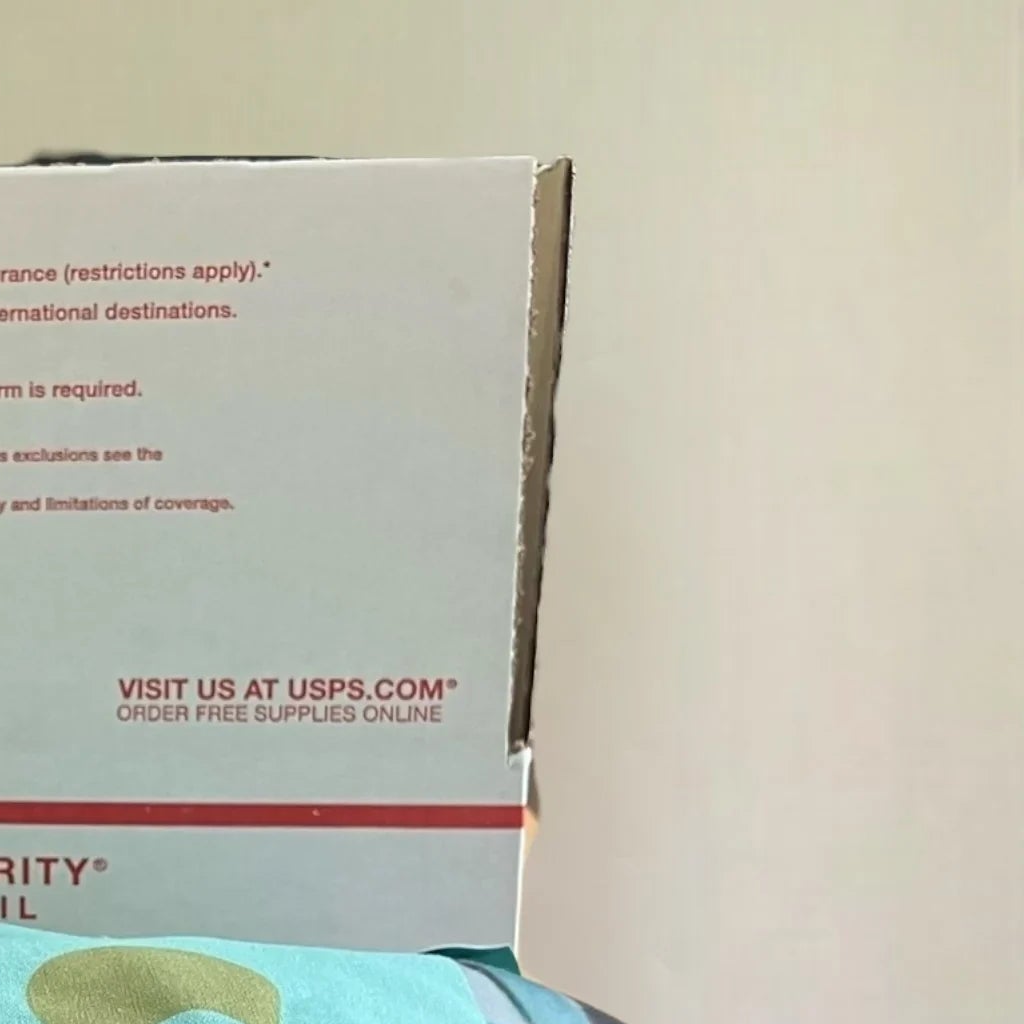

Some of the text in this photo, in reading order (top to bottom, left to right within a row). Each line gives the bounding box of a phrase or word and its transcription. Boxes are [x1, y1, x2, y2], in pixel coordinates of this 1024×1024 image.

[64, 262, 186, 285] (restrictions
[105, 301, 237, 320] destinations.
[29, 381, 46, 398] is
[52, 380, 142, 401] required.
[119, 678, 189, 700] VISIT
[198, 678, 235, 700] US
[244, 678, 279, 700] AT
[117, 704, 442, 723] ORDER FREE SUPPLIES ONLINE
